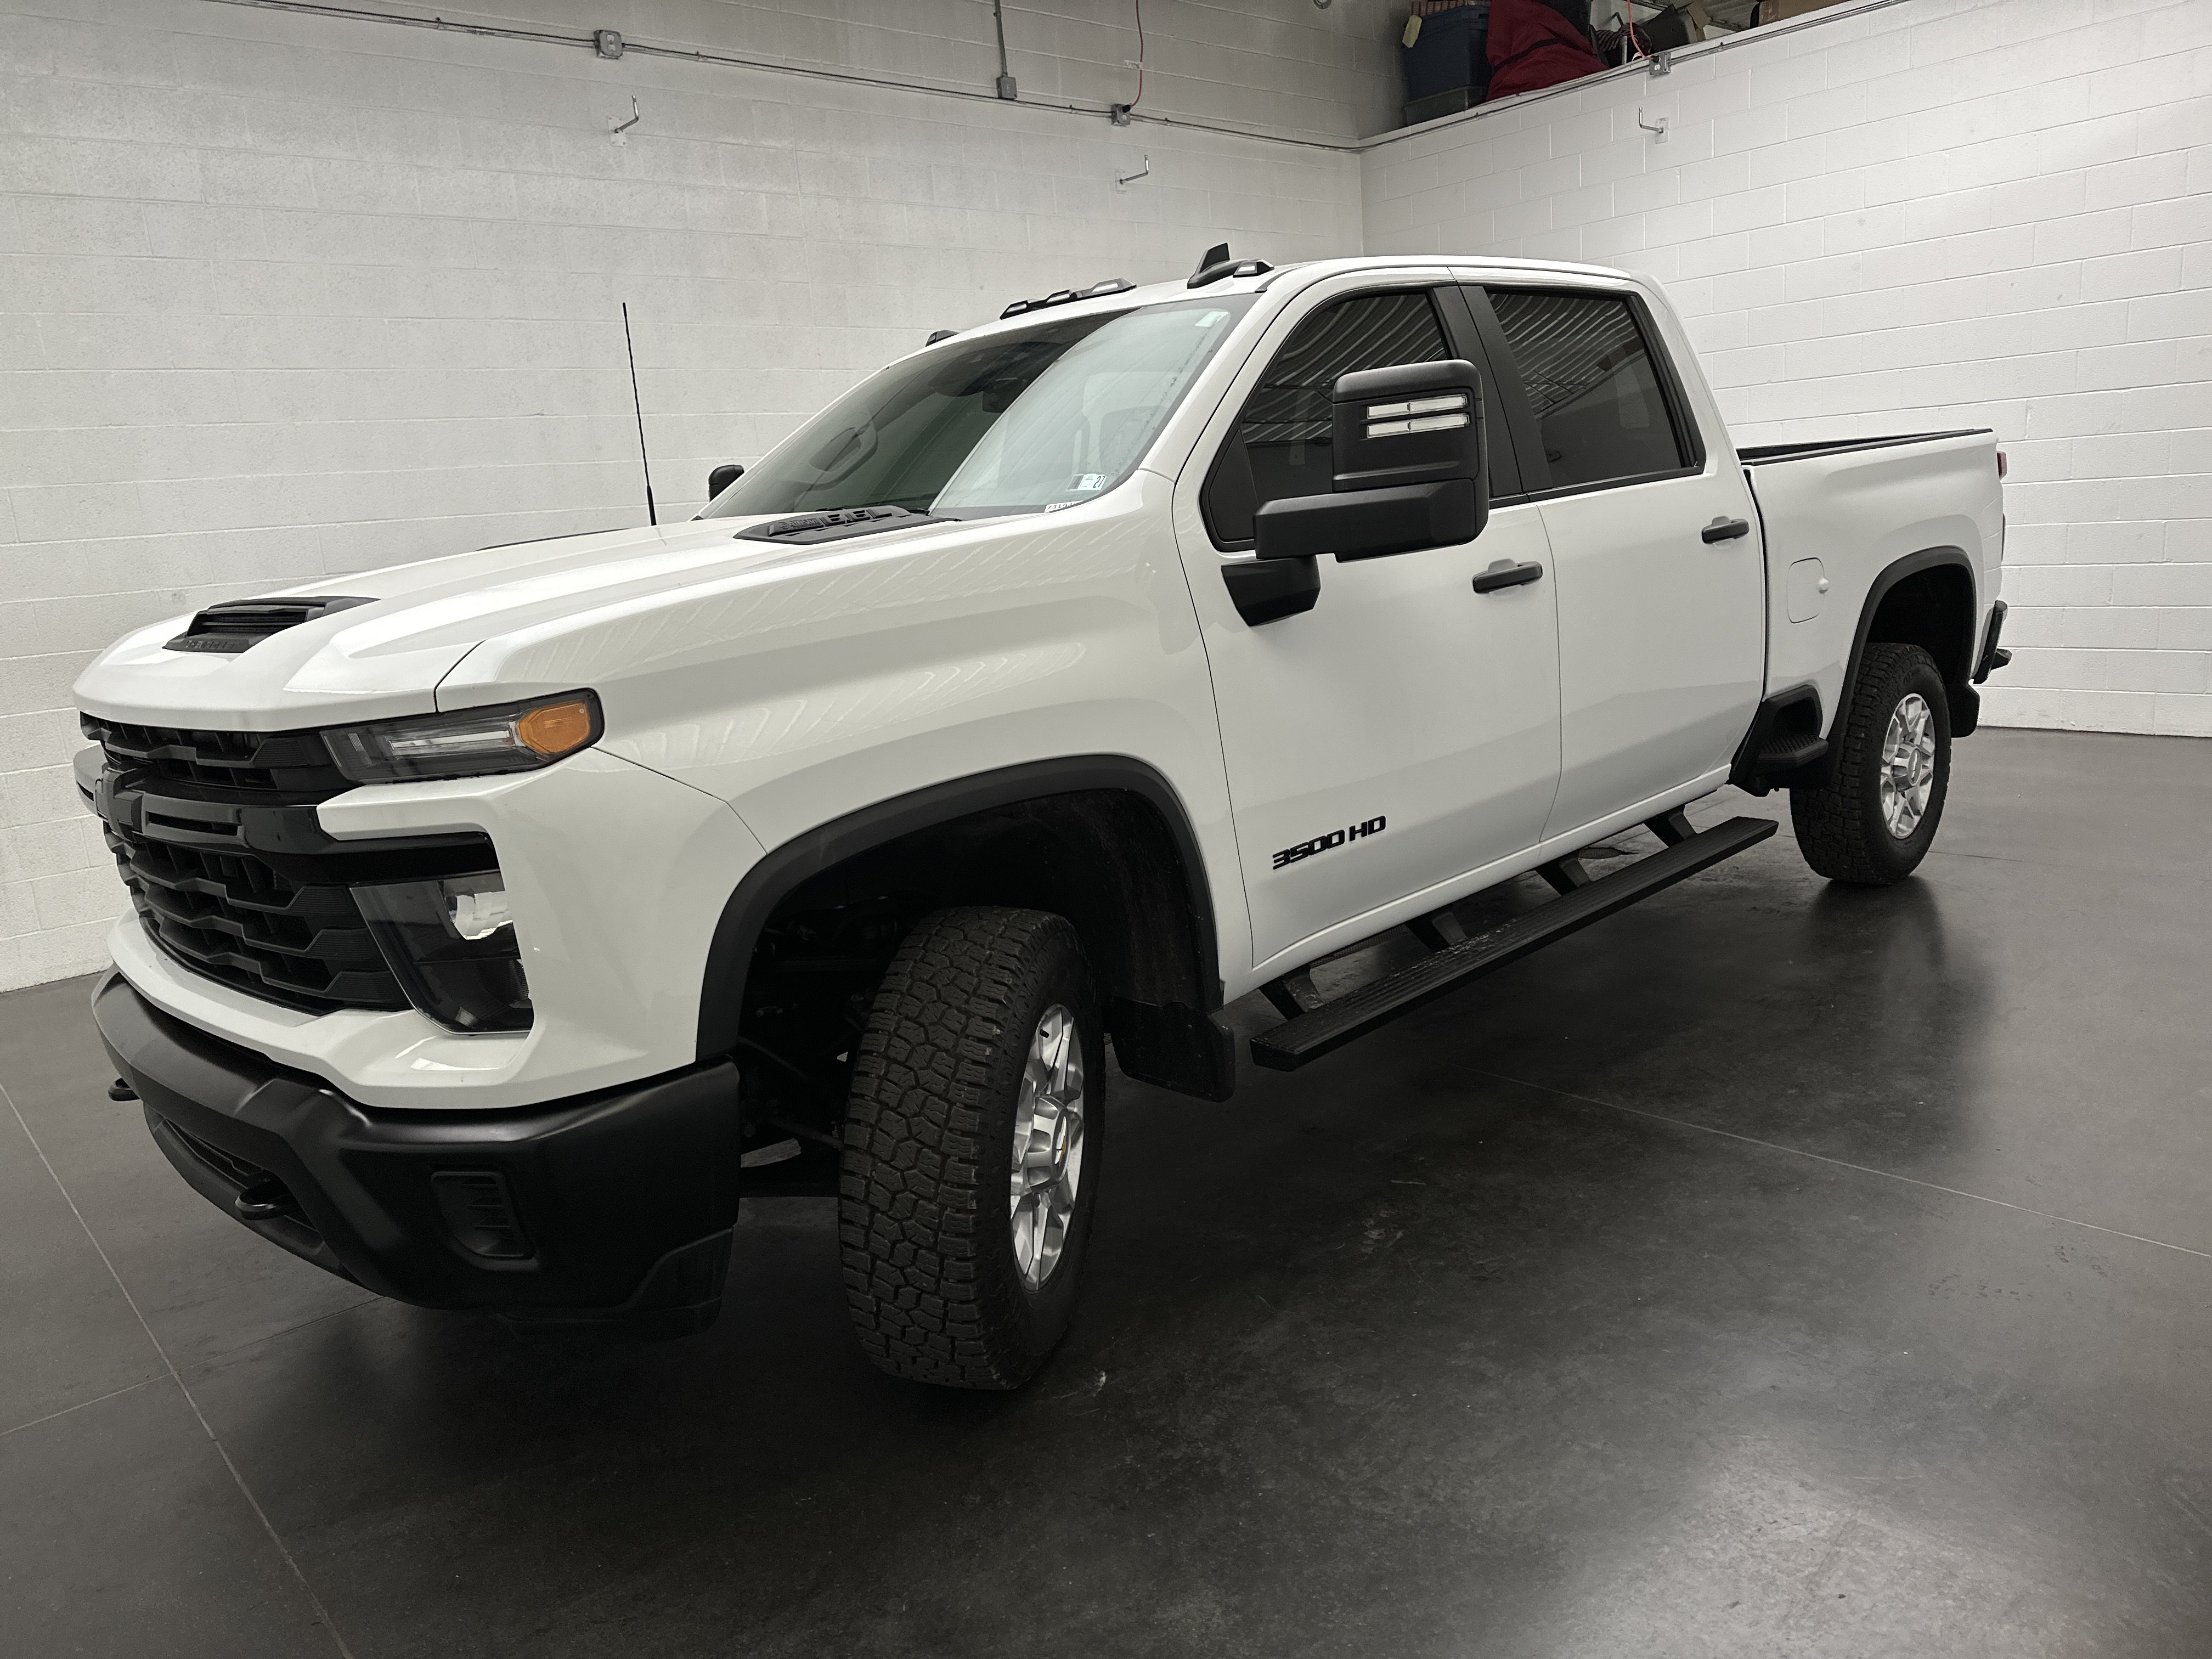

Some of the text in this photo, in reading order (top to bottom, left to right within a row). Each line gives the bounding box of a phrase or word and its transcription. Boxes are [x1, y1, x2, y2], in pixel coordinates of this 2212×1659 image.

[1092, 475, 1107, 488] 27
[1272, 815, 1386, 870] 3500 HD
